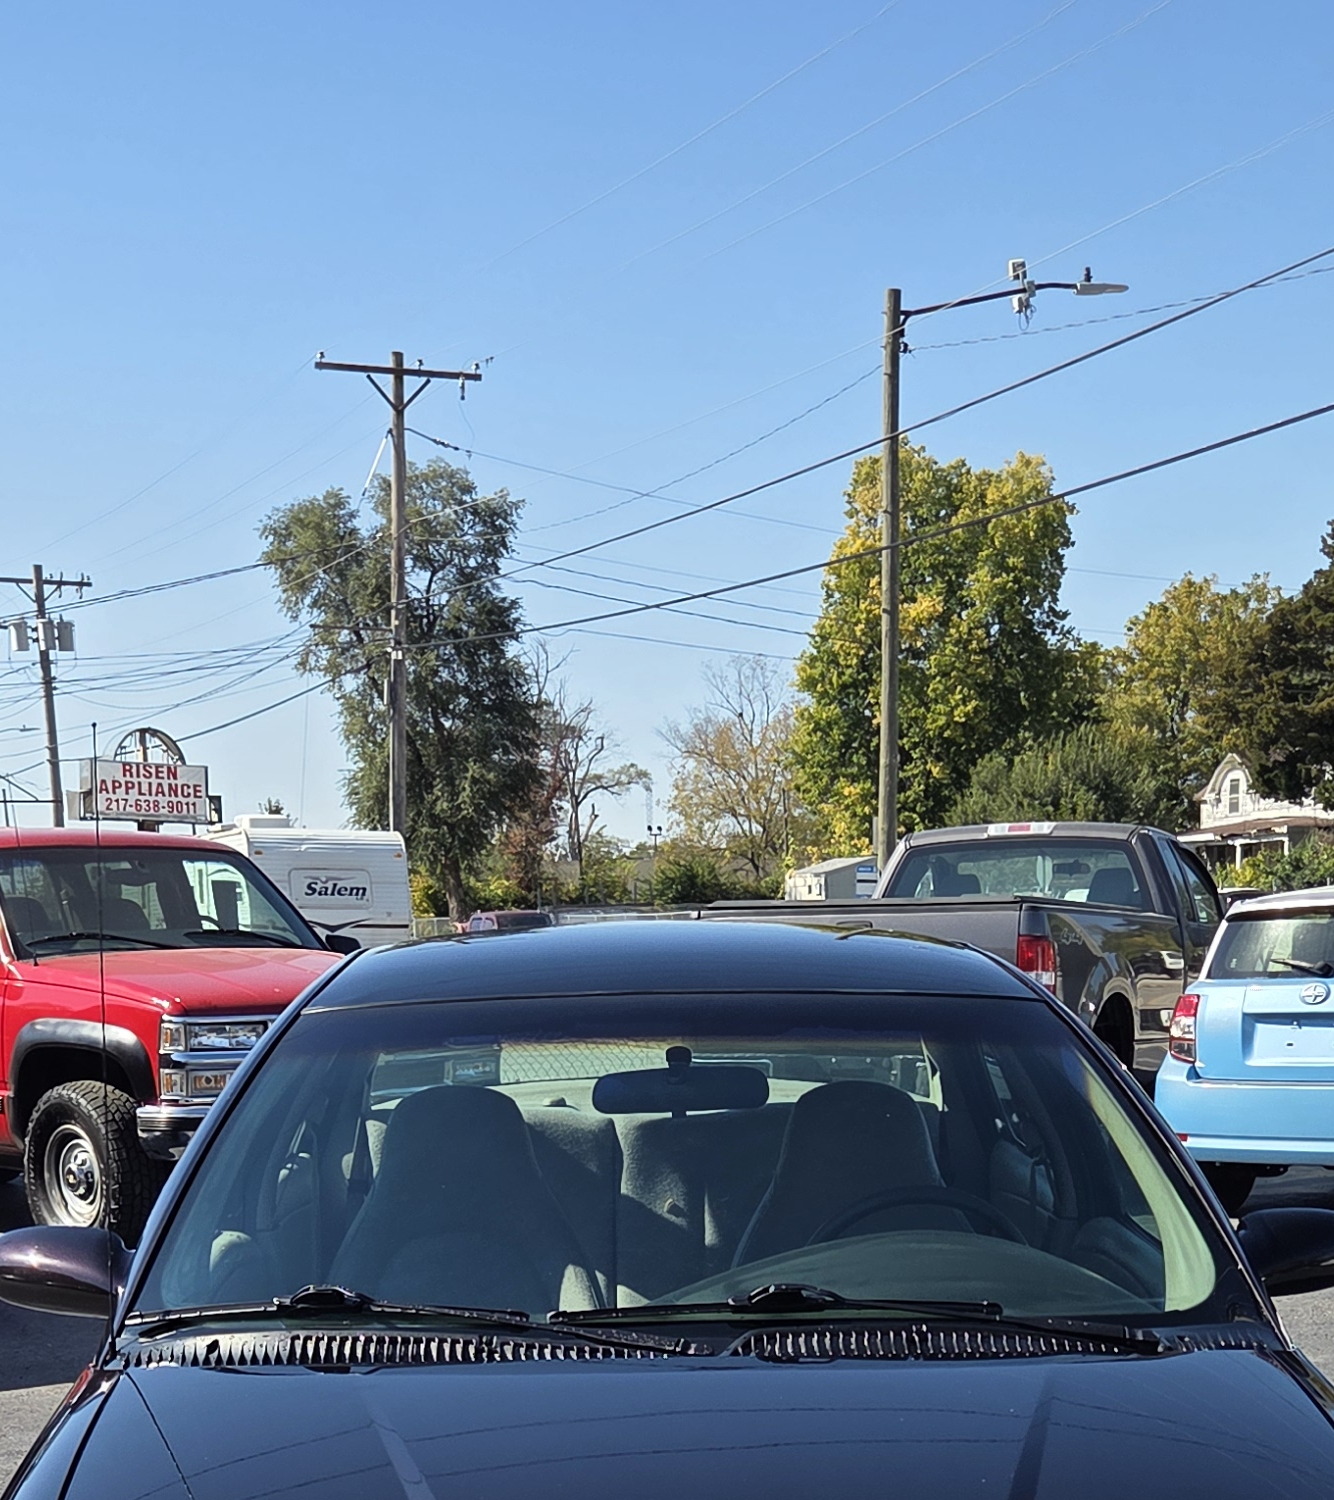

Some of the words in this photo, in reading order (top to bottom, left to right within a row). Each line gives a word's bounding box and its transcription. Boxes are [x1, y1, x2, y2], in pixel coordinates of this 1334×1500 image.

[121, 763, 178, 780] RISEN
[99, 779, 203, 798] APPLIANCE
[105, 797, 197, 814] 217-638-9011
[304, 881, 367, 896] Salem
